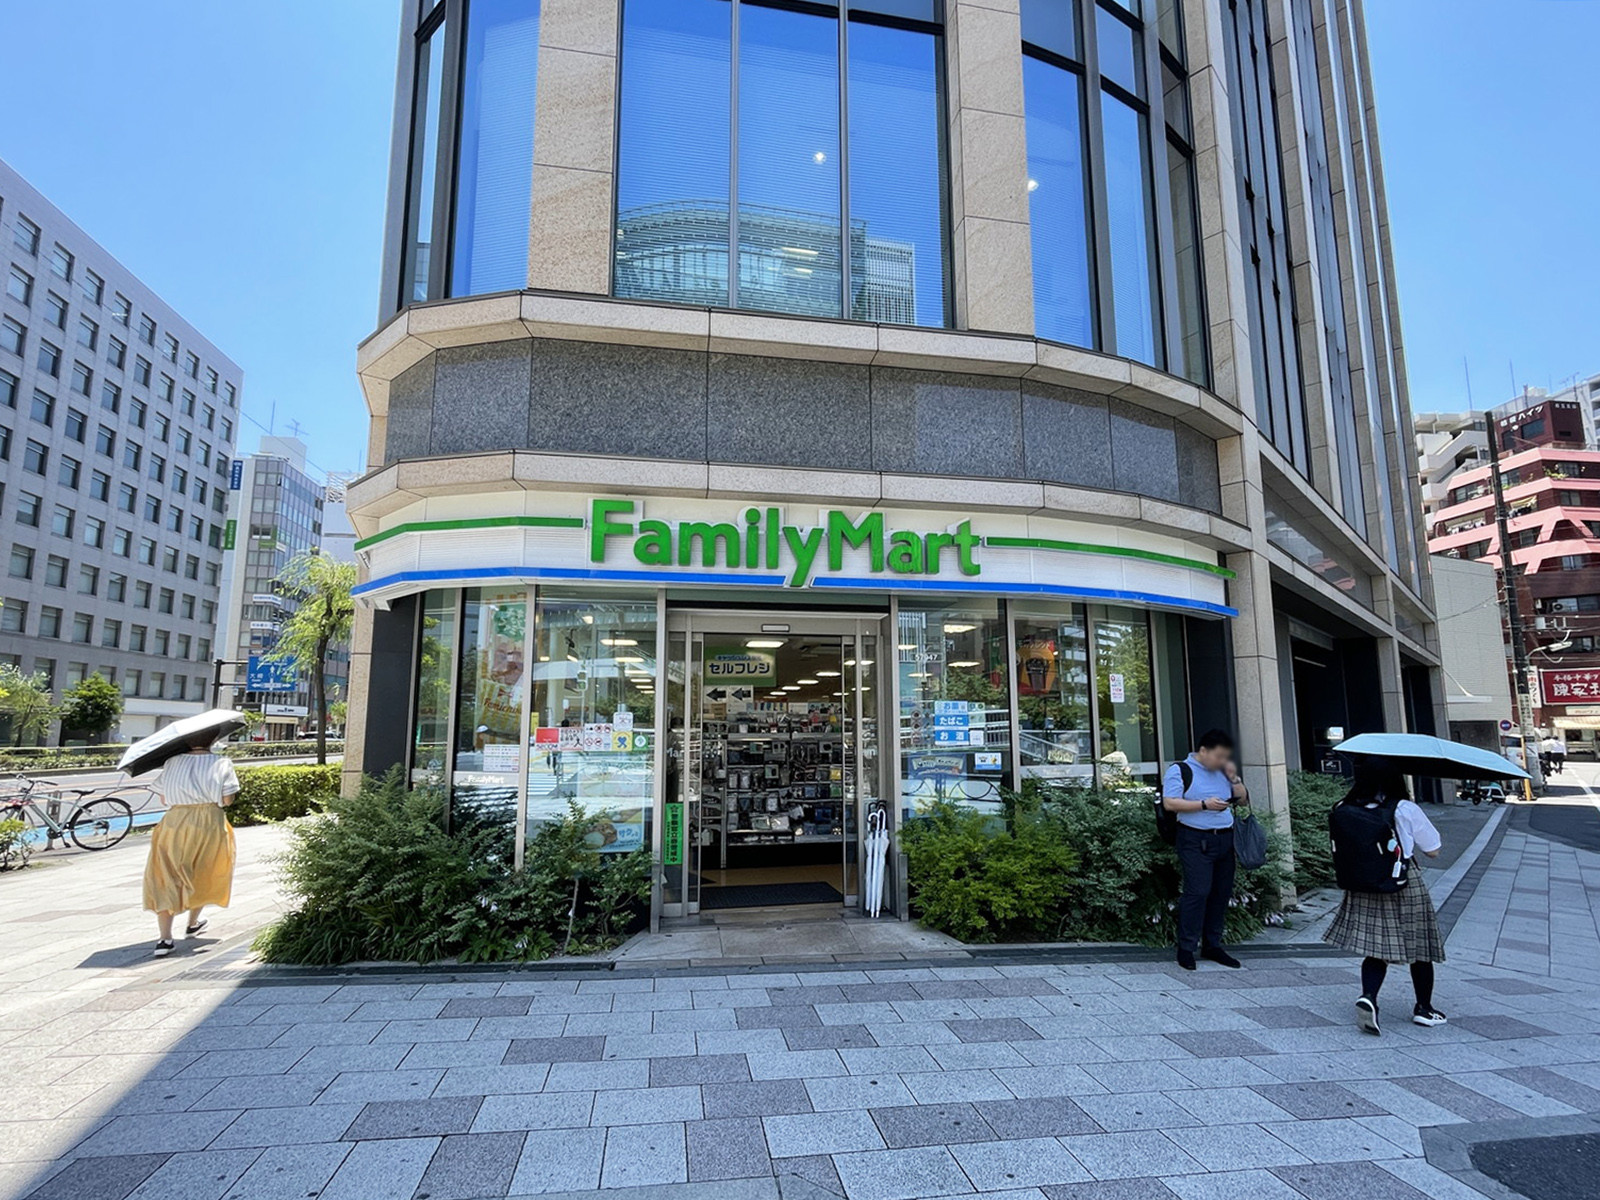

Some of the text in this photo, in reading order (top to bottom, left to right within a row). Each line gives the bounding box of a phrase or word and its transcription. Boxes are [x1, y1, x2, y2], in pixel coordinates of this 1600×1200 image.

[590, 499, 981, 588] FamilyMart
[709, 662, 770, 674] セルフレジ
[939, 716, 964, 726] たばこ
